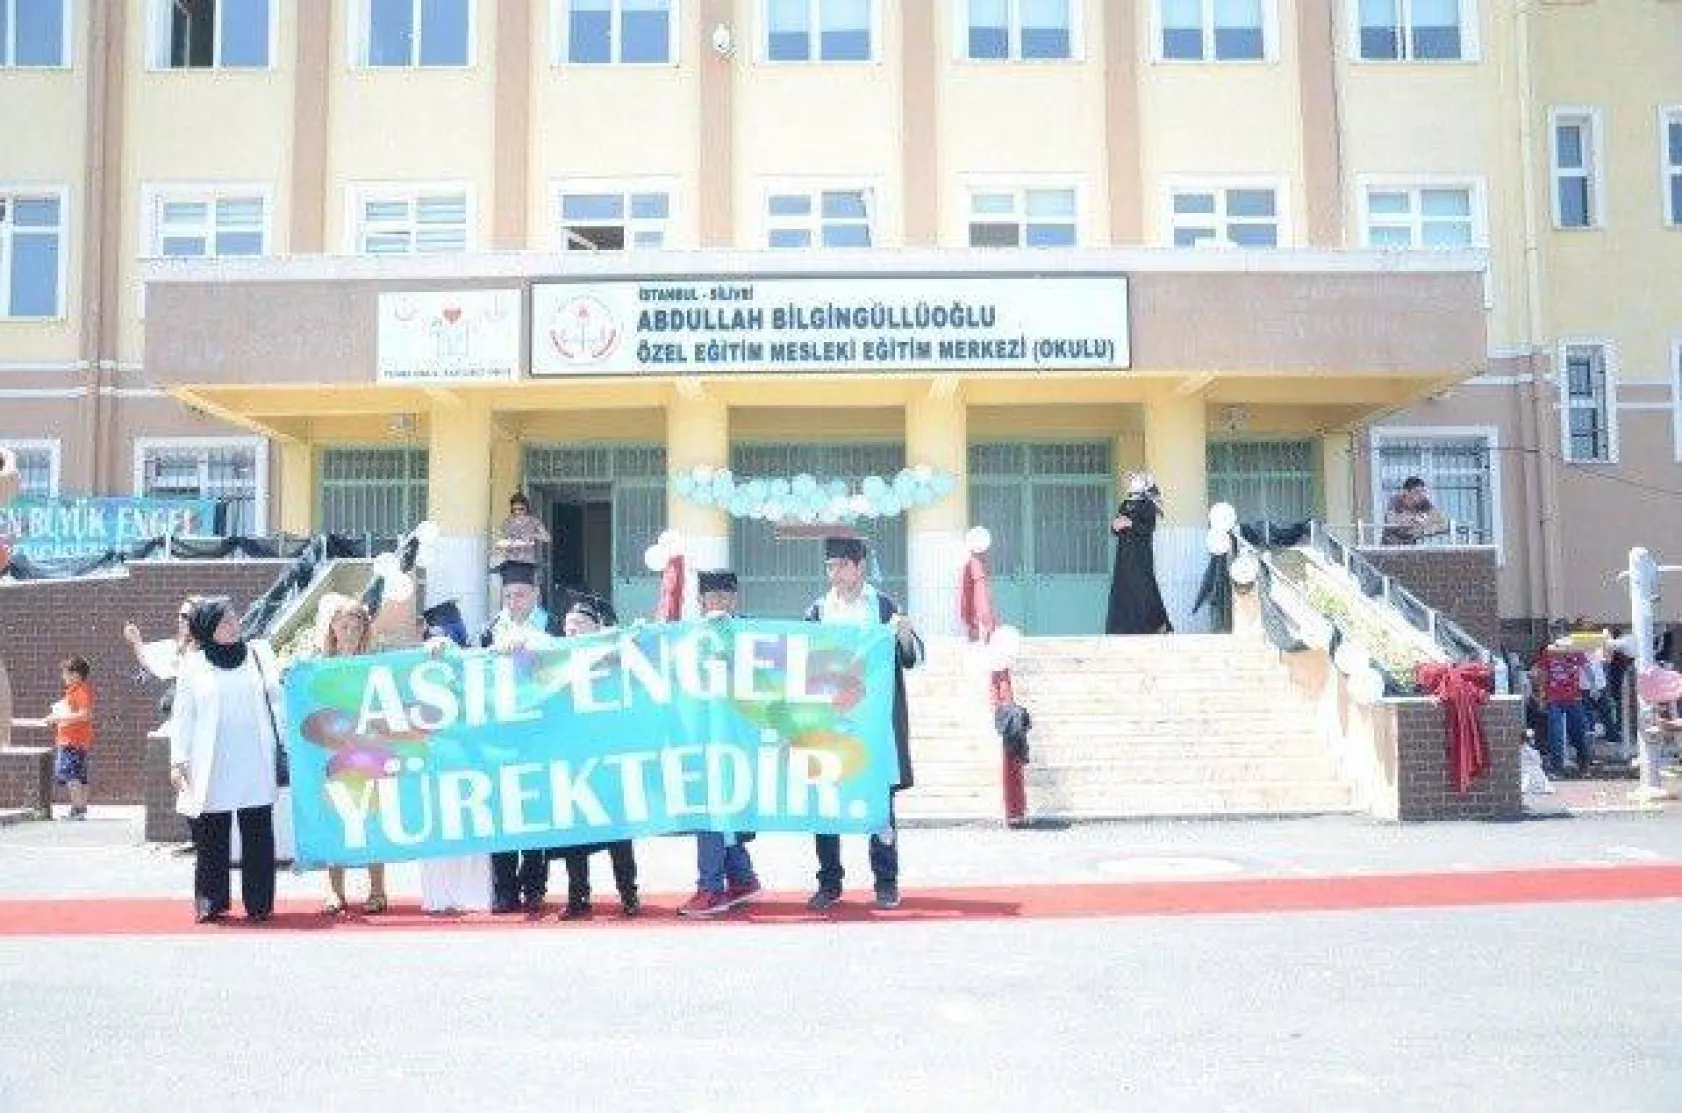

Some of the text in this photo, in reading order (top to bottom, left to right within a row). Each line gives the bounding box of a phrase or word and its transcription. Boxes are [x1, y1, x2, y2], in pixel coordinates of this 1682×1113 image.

[637, 301, 996, 331] ABDULLAH BİLGİNGÜLLÜOĞLU
[637, 333, 1115, 363] ÖZEL EĞİTİM MESLEKİ EĞİTİM MERKEZİ (OKULU)
[573, 632, 839, 716] ENGEL
[325, 728, 869, 850] YÜREKTEDİR.
